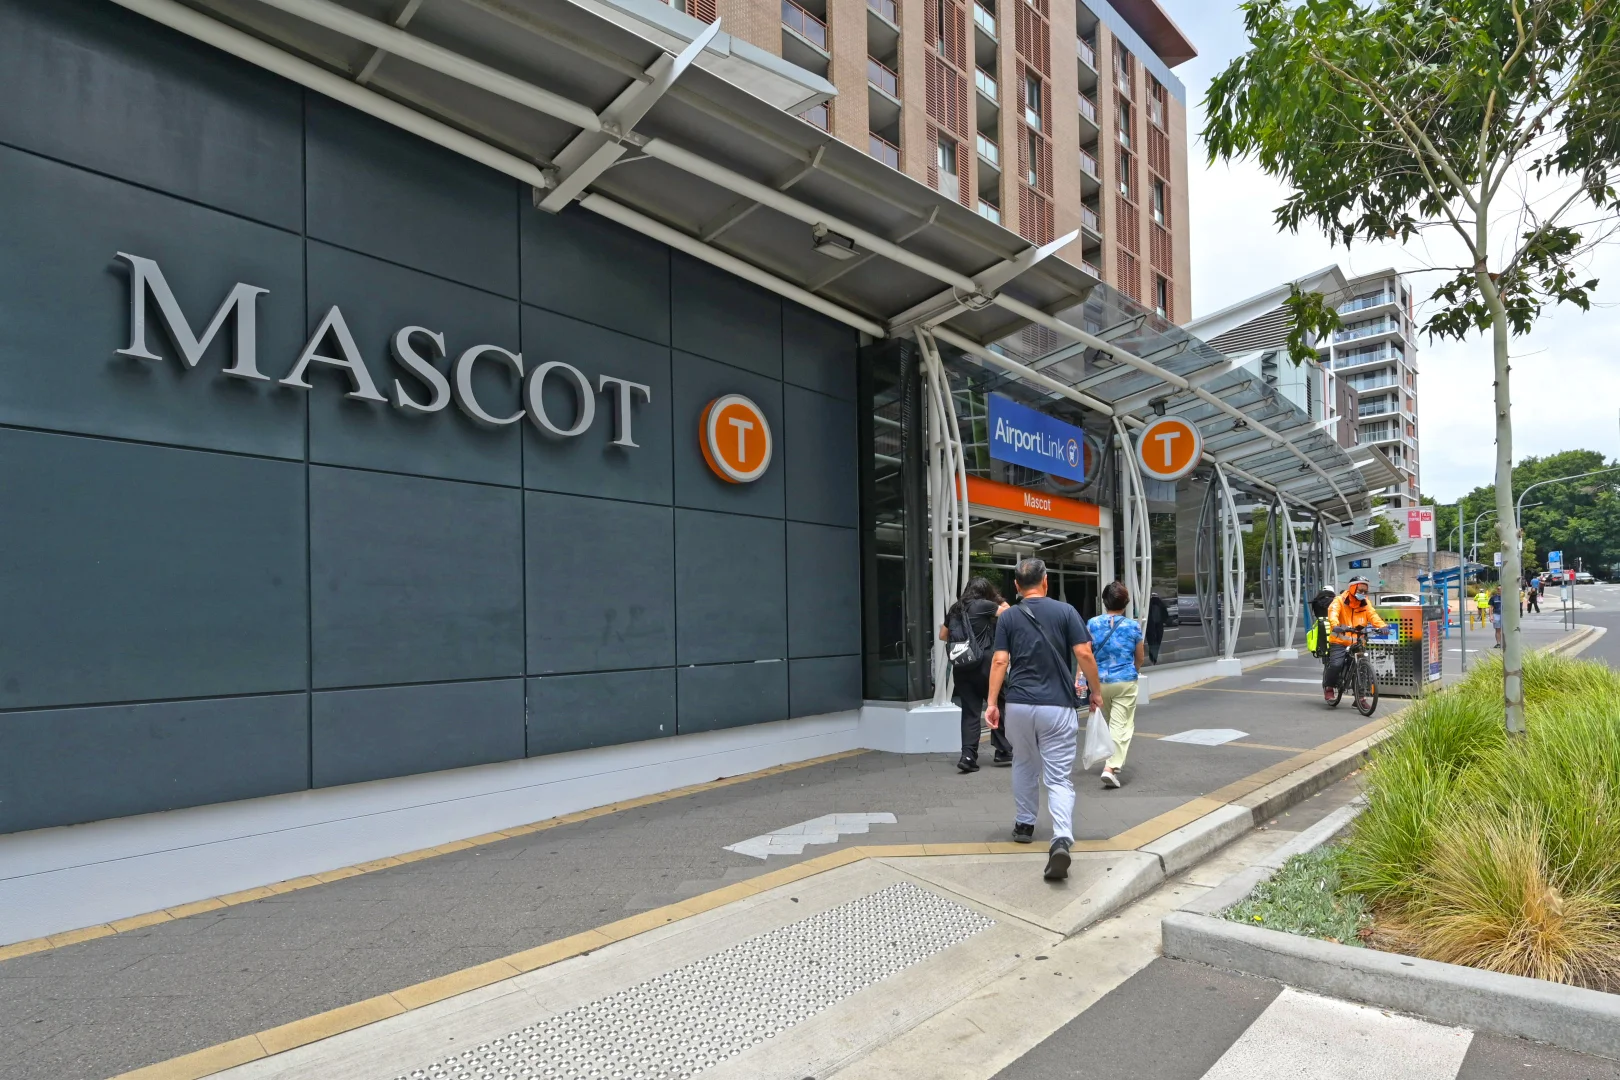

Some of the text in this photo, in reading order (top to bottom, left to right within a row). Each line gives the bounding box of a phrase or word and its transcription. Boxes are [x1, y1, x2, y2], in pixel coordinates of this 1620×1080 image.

[113, 250, 651, 447] MASCOT
[729, 417, 753, 463] T
[995, 417, 1065, 461] AirportLink
[1155, 431, 1180, 467] T
[1023, 492, 1052, 511] Mascot
[954, 655, 972, 665] AIR
